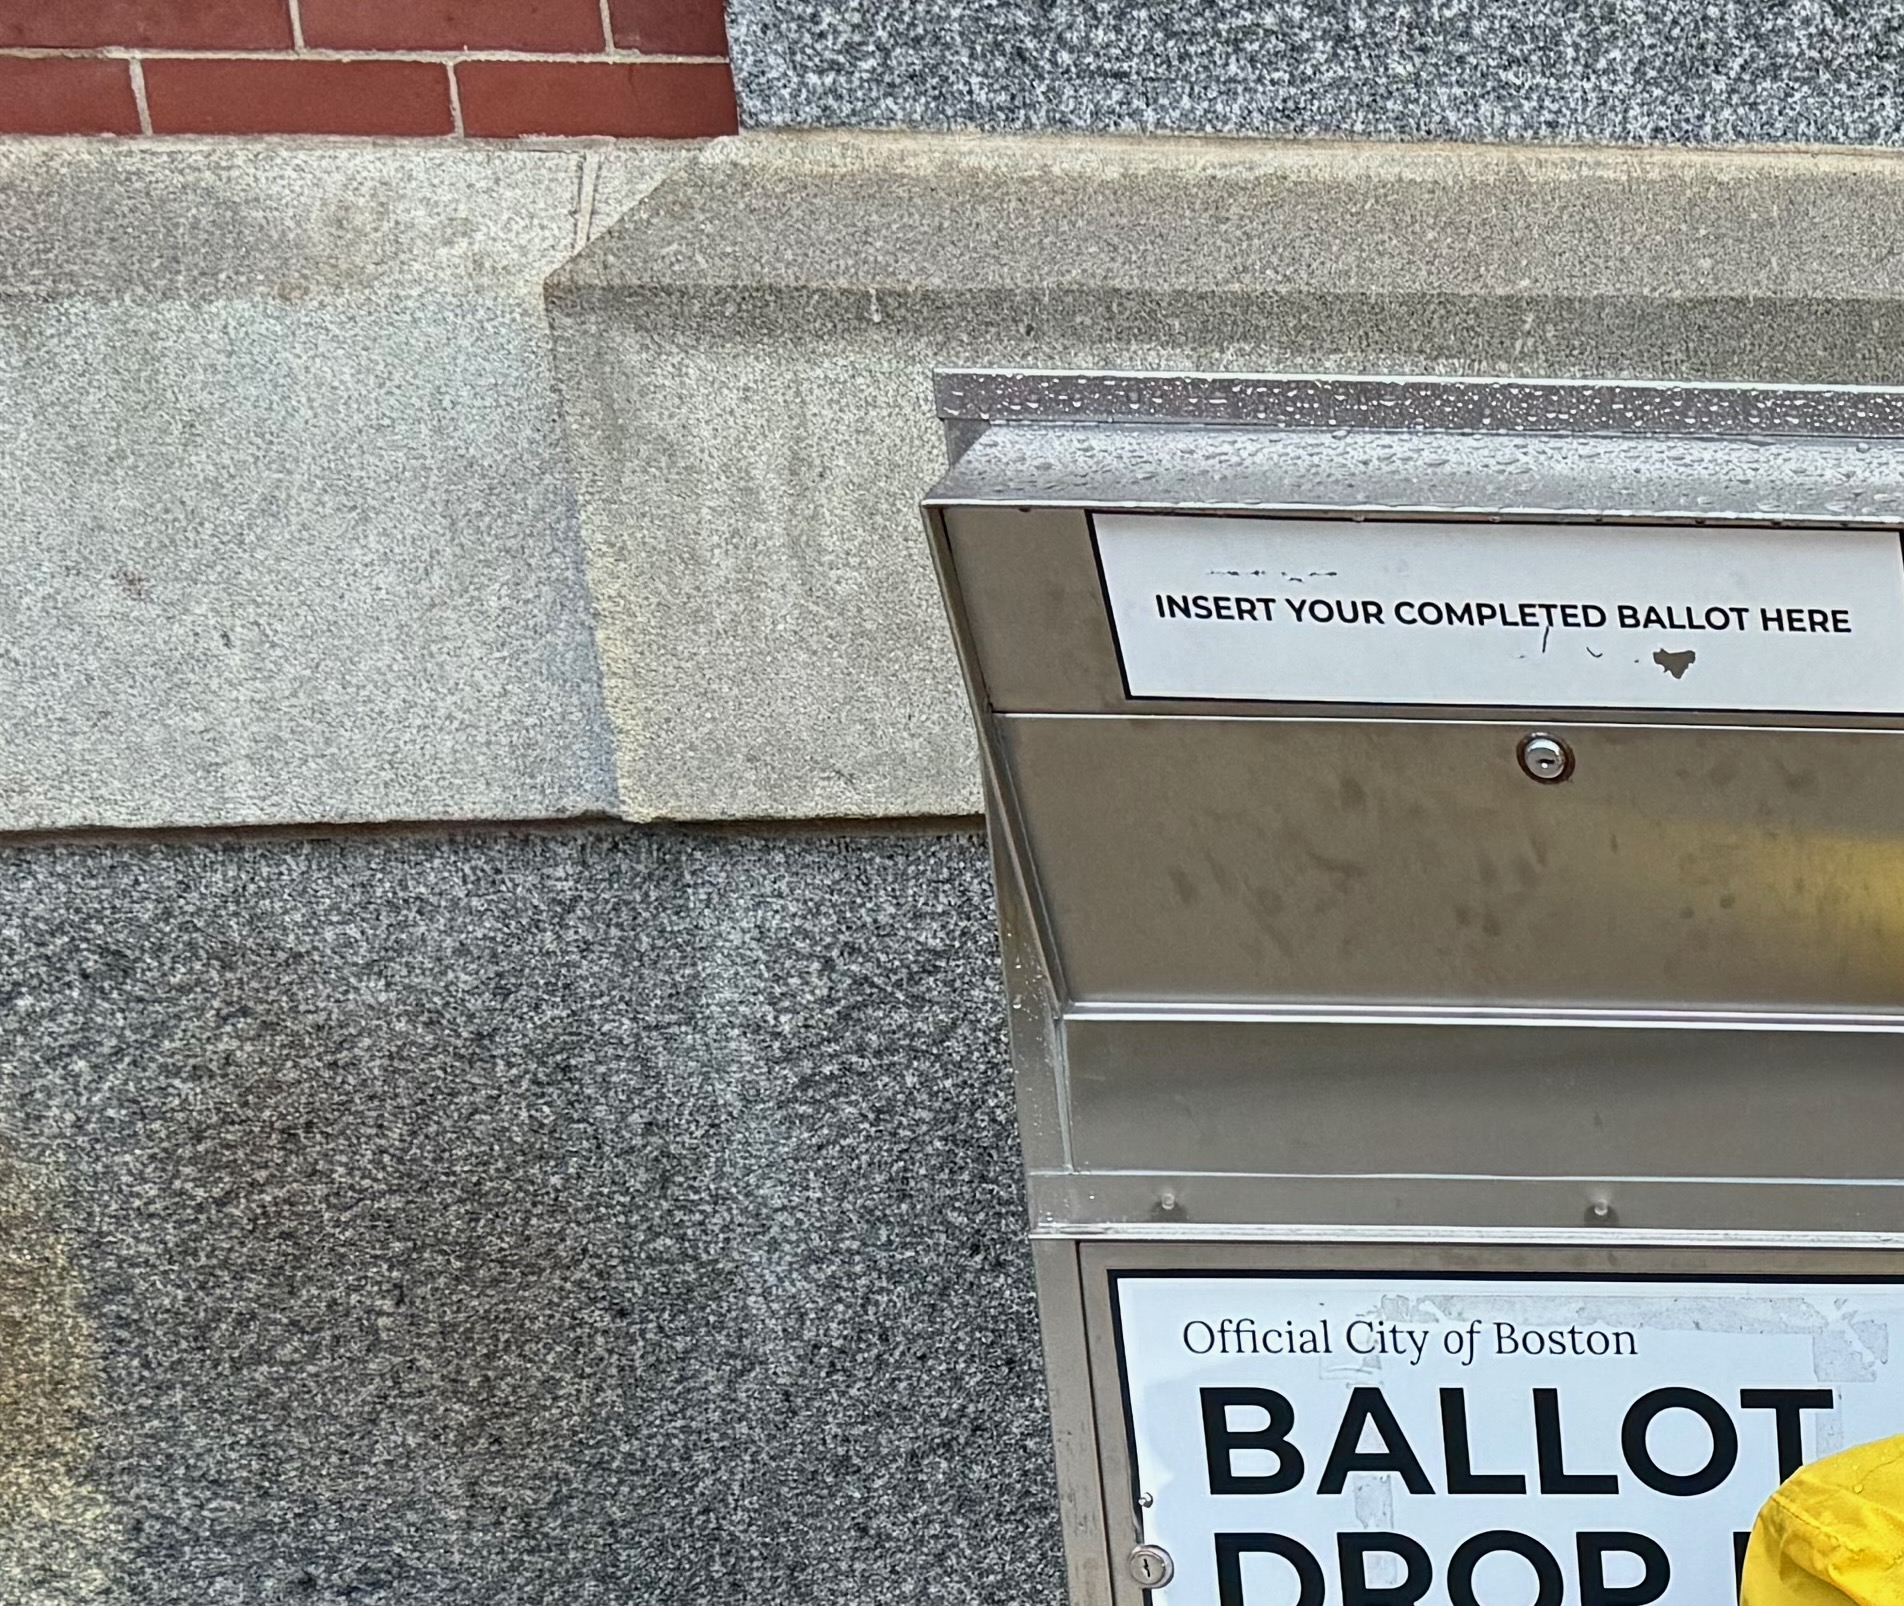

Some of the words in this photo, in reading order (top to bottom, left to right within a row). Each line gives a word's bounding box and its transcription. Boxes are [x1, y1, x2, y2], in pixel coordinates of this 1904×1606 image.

[1155, 594, 1276, 622] INSERT
[1285, 598, 1385, 625] YOUR
[1394, 601, 1607, 628] COMPLETED
[1618, 605, 1750, 631] BALLOT
[1761, 607, 1852, 633] HERE
[1183, 1318, 1333, 1354] Official
[1346, 1320, 1429, 1366] City
[1443, 1319, 1481, 1366] of
[1494, 1322, 1638, 1355] Boston
[1199, 1386, 1834, 1497] BALLOT
